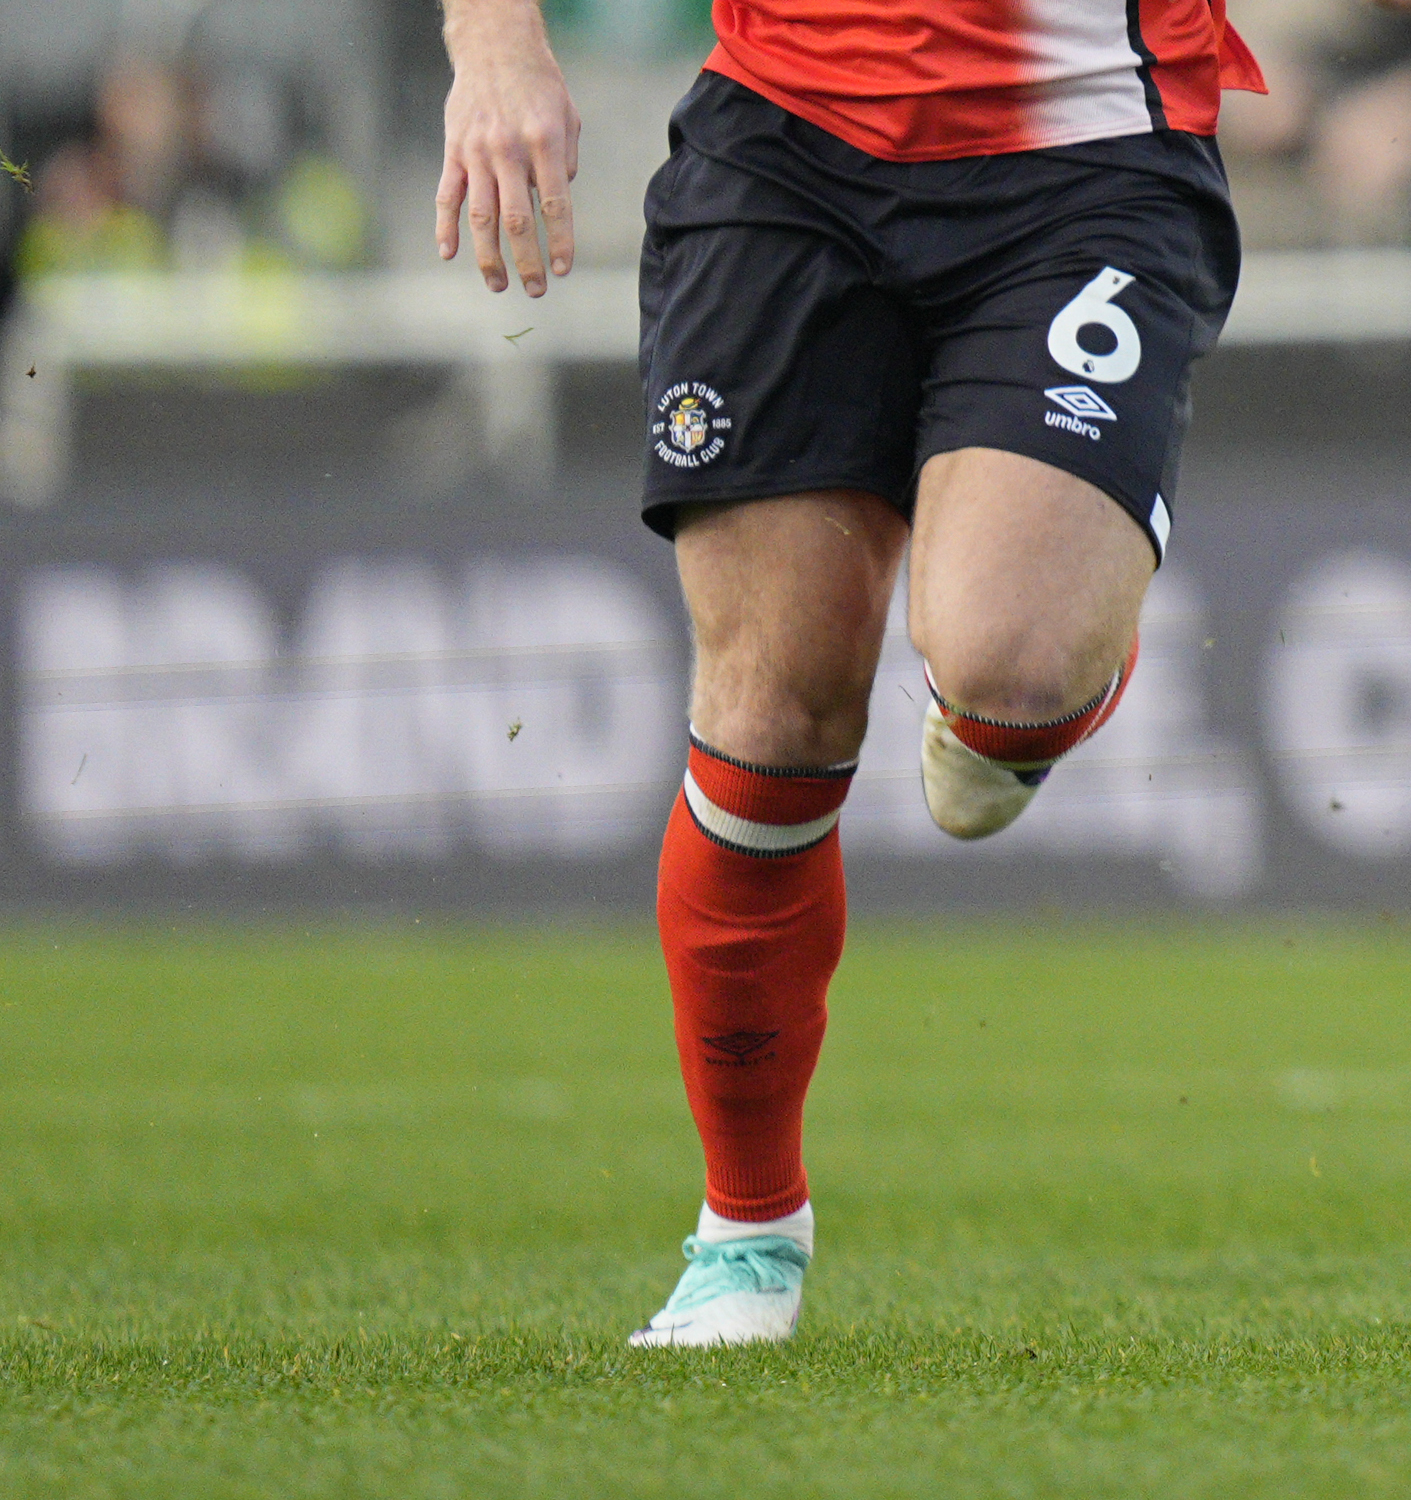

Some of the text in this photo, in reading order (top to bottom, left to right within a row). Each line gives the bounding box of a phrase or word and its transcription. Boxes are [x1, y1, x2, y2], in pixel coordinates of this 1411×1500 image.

[1047, 266, 1141, 383] 6
[658, 382, 725, 412] LUTON TOWN
[712, 418, 732, 428] 1885
[1044, 411, 1100, 440] umbro
[654, 437, 725, 467] FOOTBALL CLUB
